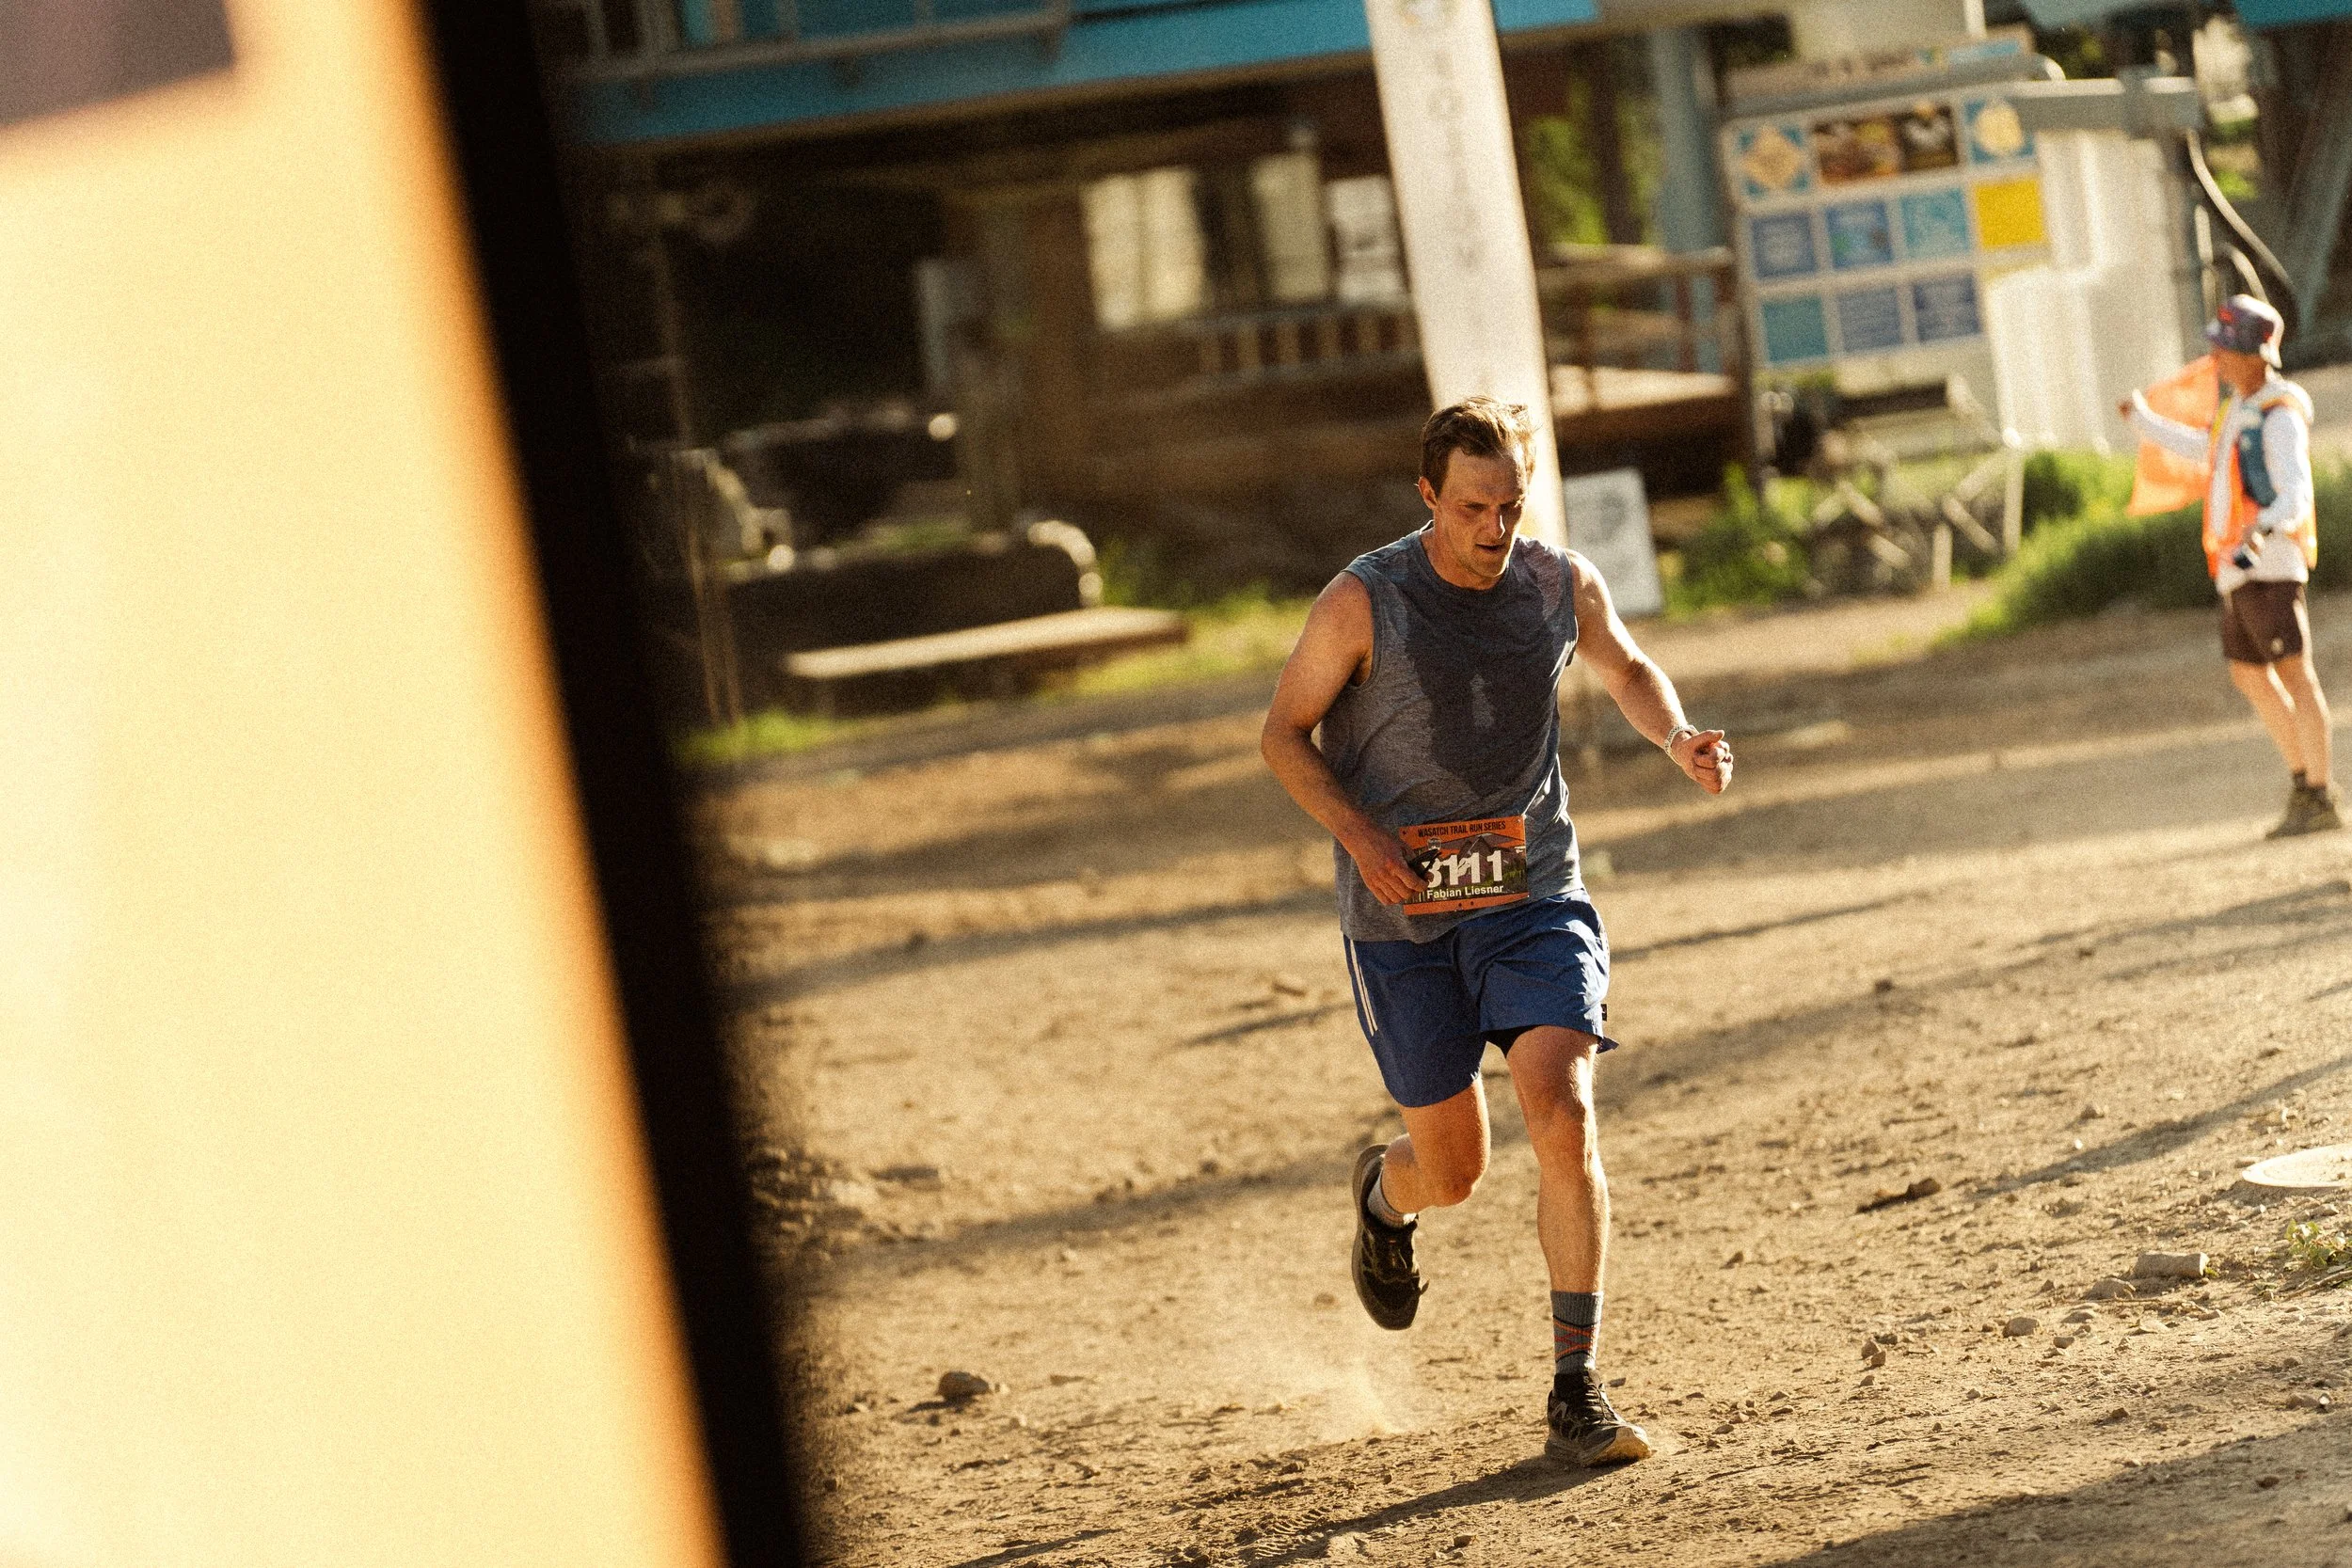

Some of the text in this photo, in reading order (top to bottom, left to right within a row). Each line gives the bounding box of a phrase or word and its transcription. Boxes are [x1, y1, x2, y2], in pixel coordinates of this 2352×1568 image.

[1418, 821, 1506, 837] WASATCH TRAIL RUN SERIES
[1427, 885, 1504, 899] Fabian Liesner
